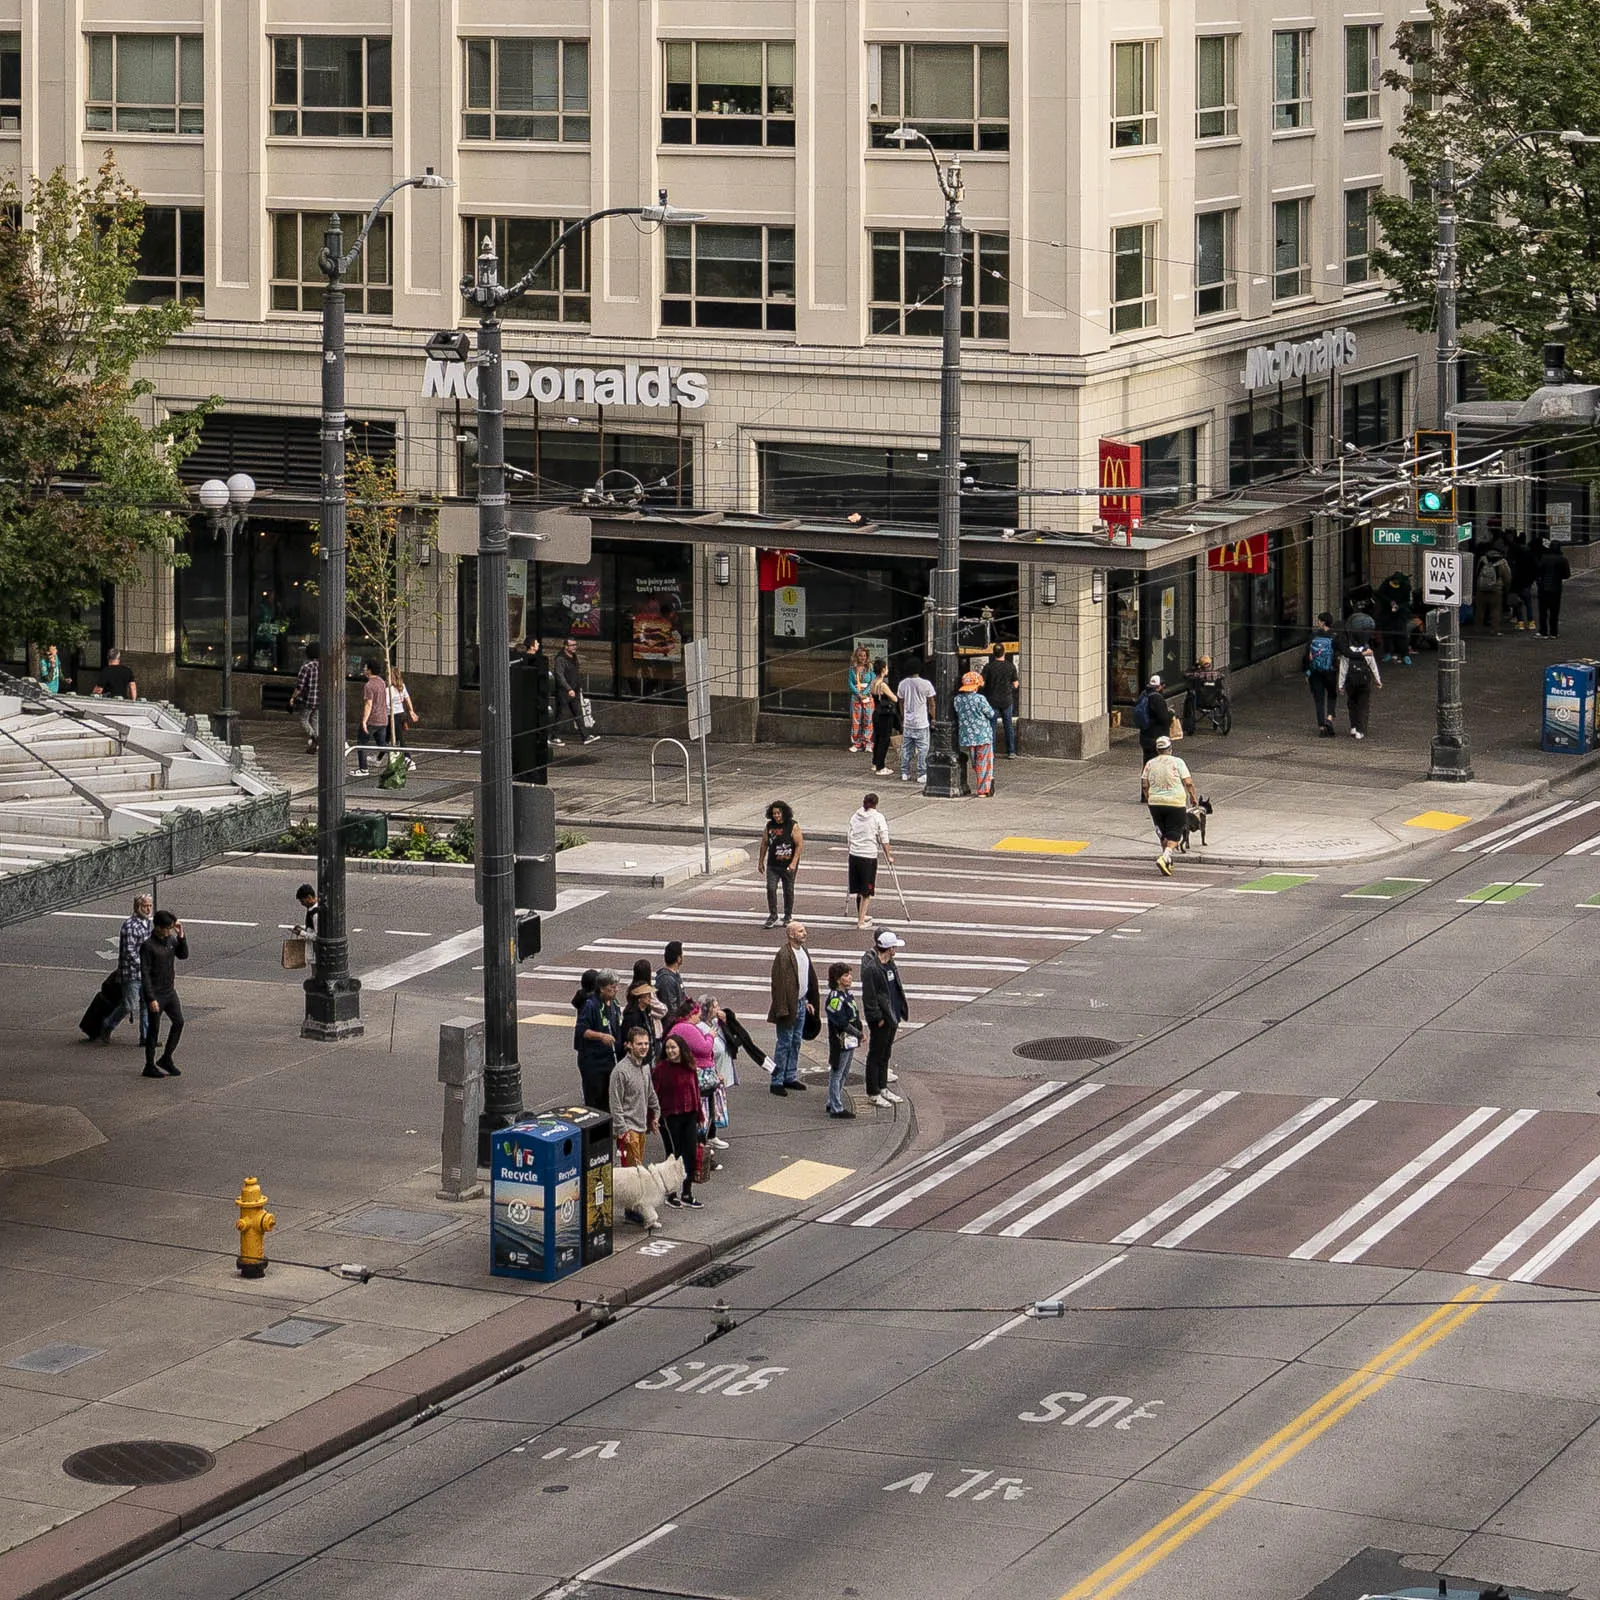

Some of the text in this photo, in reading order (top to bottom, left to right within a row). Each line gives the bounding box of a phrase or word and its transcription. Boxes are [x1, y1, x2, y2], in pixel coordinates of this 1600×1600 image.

[1243, 326, 1357, 390] McDonald's
[421, 357, 709, 408] McDonald's
[1378, 528, 1401, 543] Pine
[1411, 534, 1419, 543] St
[1430, 556, 1454, 570] ONE
[1429, 570, 1455, 584] WAY
[1551, 687, 1577, 696] Recycle
[589, 1152, 610, 1168] Garbage
[501, 1167, 538, 1183] Recycle
[558, 1166, 578, 1182] Recycle
[635, 1361, 789, 1396] BUS
